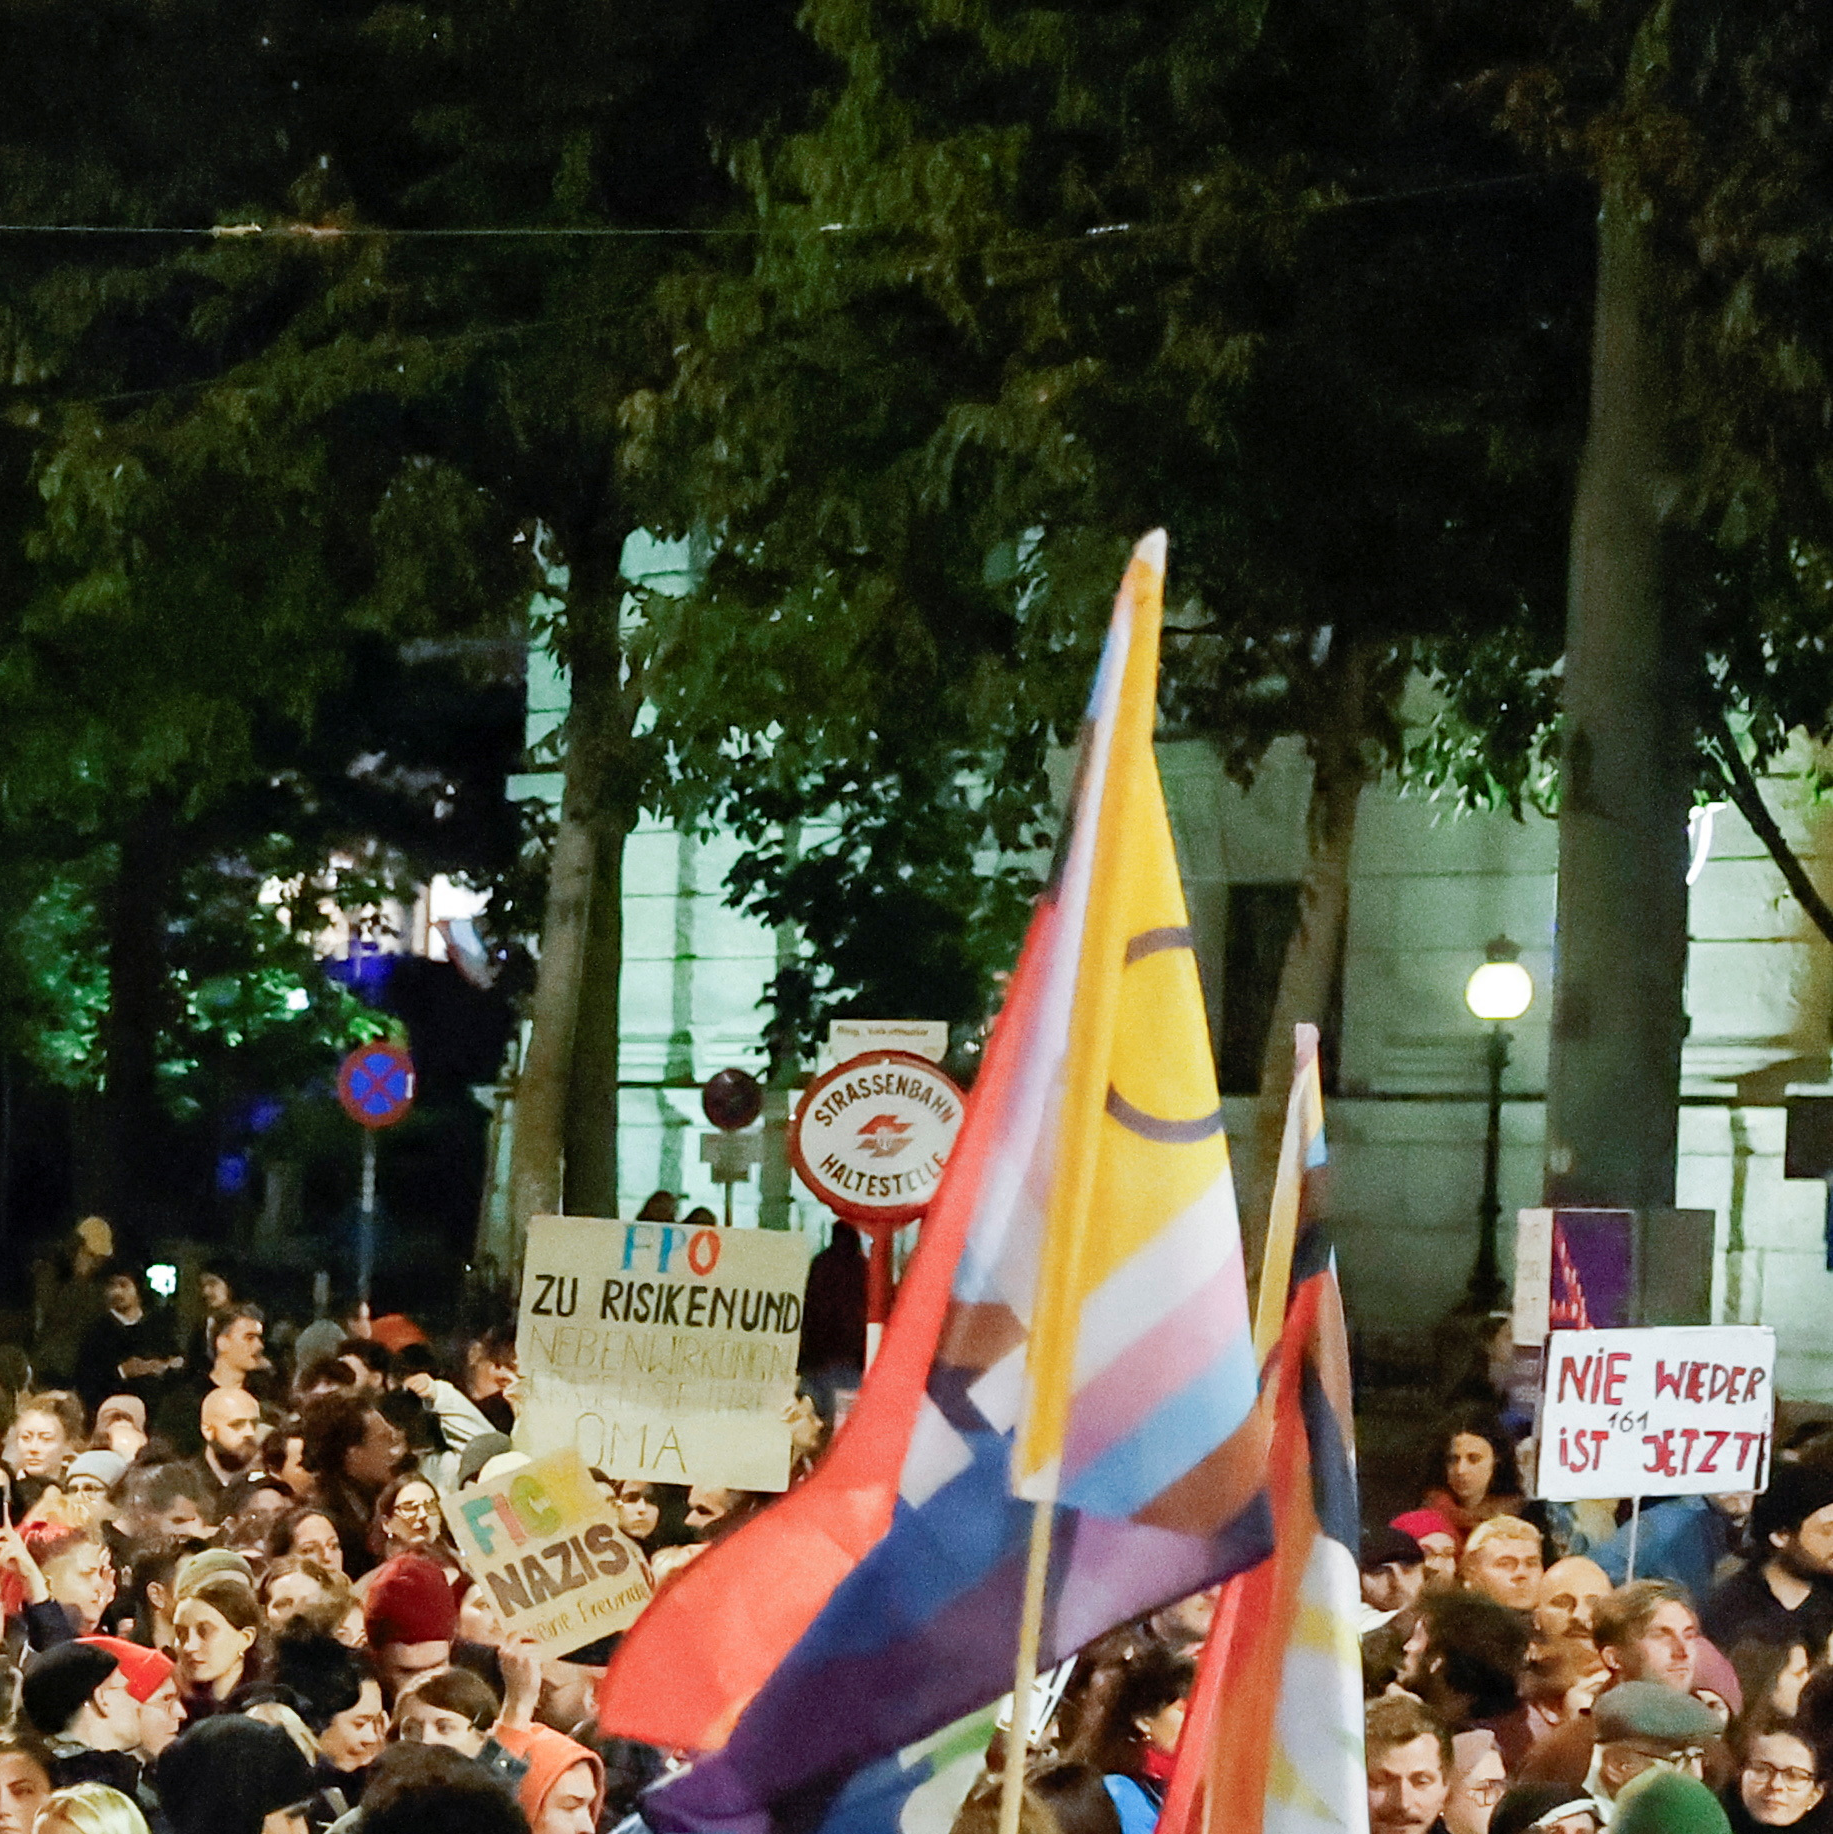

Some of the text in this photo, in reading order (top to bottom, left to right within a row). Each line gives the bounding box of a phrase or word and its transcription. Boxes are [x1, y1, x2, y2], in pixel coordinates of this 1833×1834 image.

[815, 1073, 955, 1127] STRASSENBAHN
[819, 1152, 945, 1197] HALTESTELLE
[531, 1274, 578, 1318] ZU
[575, 1411, 687, 1474] OMA
[485, 1522, 630, 1619] NAZIS
